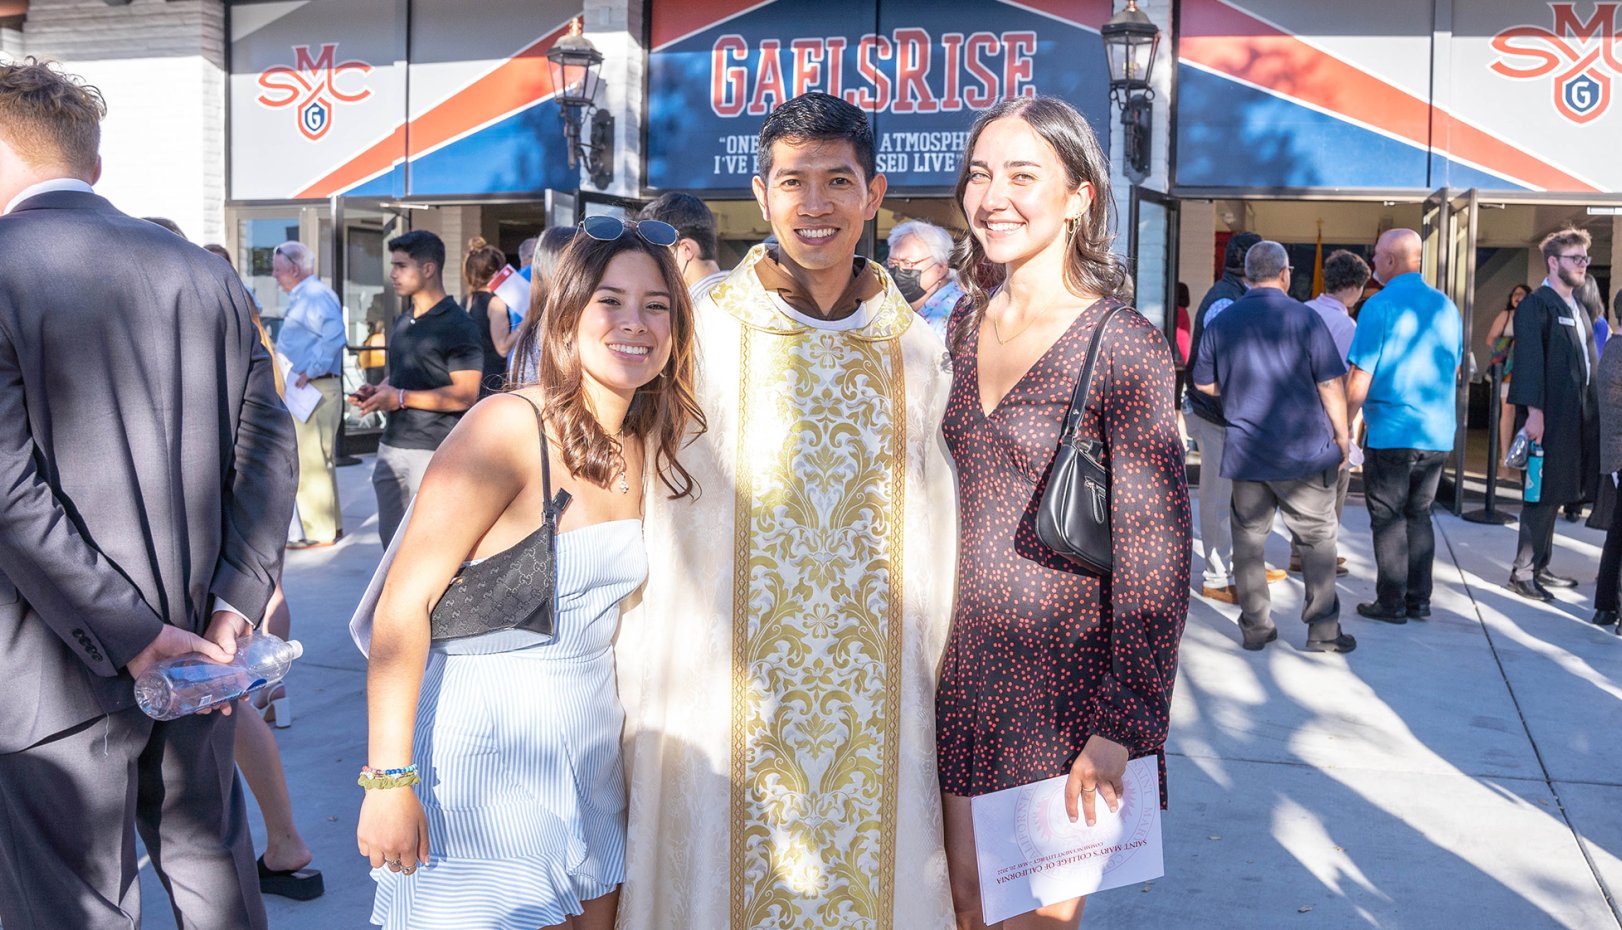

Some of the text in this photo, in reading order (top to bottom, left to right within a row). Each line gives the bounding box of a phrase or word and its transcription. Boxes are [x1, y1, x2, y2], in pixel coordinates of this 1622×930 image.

[711, 27, 1037, 118] GAELSRISE
[1571, 81, 1591, 109] G
[307, 106, 322, 130] G
[713, 155, 748, 175] I'VE
[1093, 844, 1122, 856] MARY'S
[1124, 839, 1147, 850] SAINT
[1044, 862, 1055, 870] OF
[1057, 853, 1092, 866] COLLEGE
[997, 865, 1043, 884] CALIFORNIA
